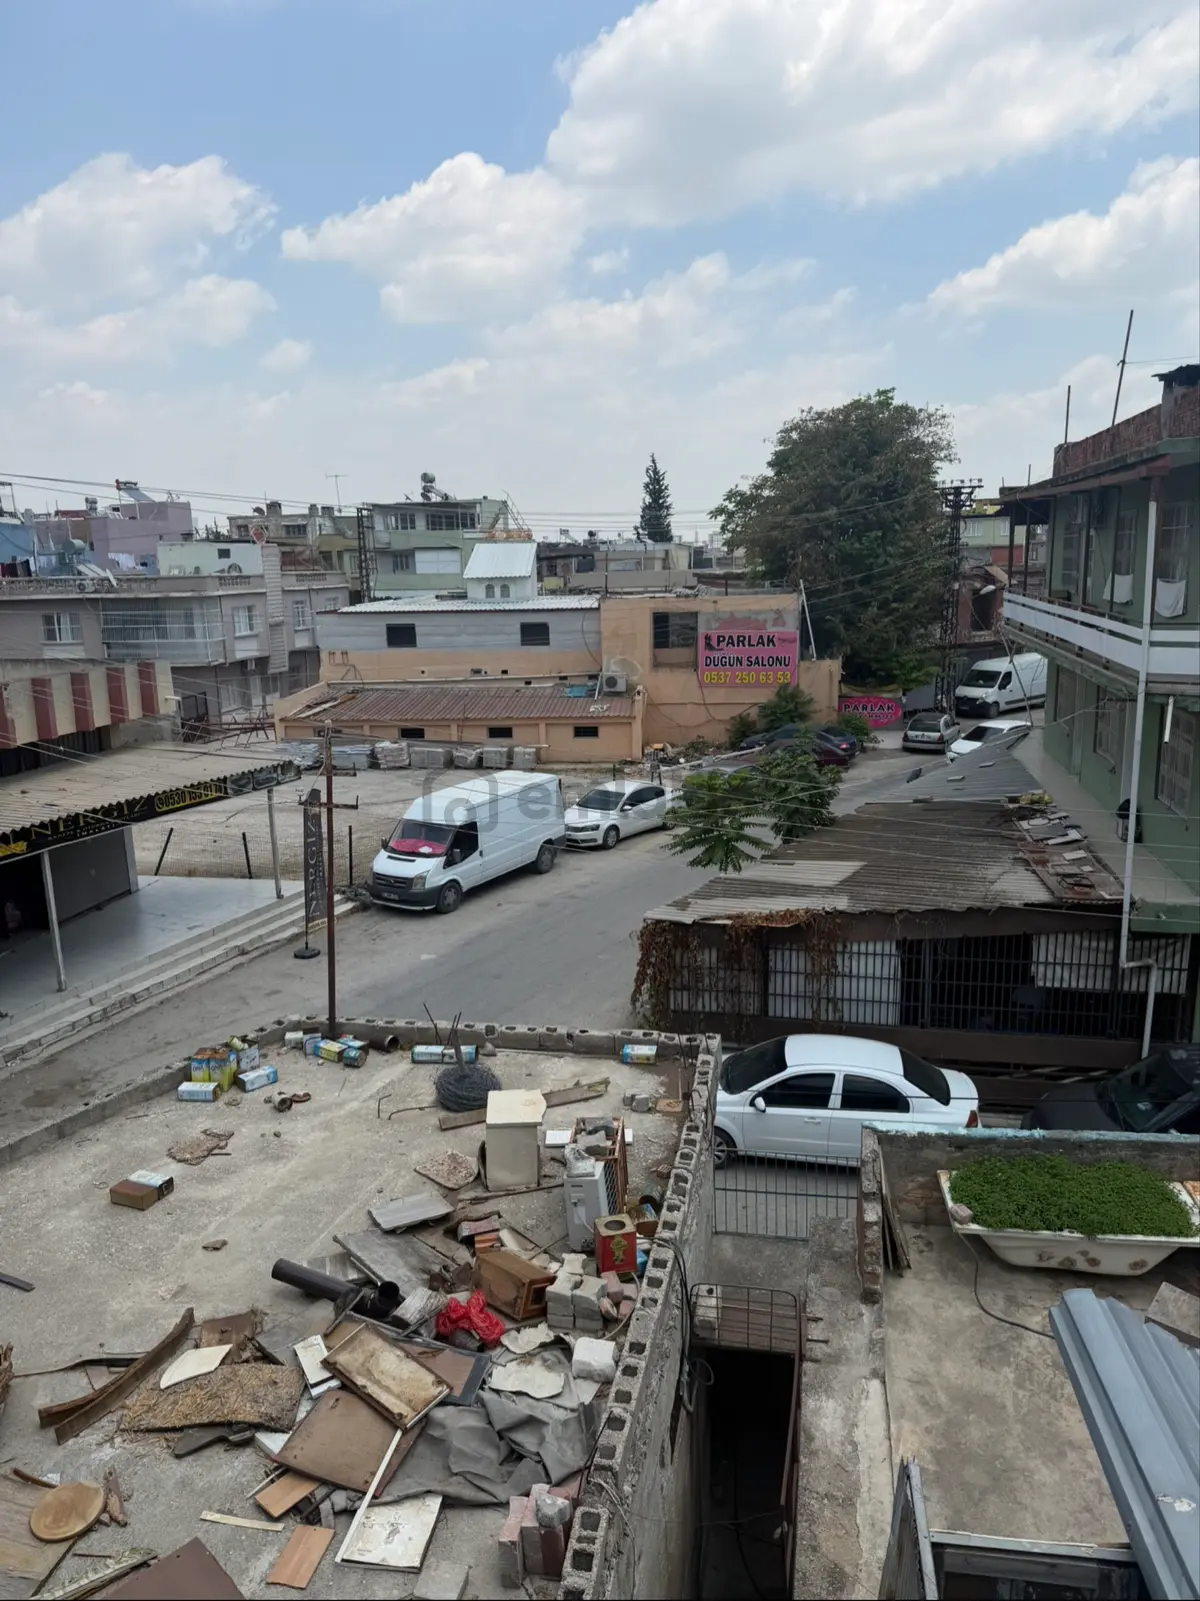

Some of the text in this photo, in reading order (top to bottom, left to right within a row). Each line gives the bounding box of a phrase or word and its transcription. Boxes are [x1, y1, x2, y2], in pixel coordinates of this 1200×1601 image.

[716, 634, 776, 647] PARLAK
[746, 655, 791, 667] SALONU
[703, 671, 731, 684] 0537
[735, 671, 755, 684] 250
[776, 671, 791, 684] 53
[843, 703, 894, 712] PARLAK
